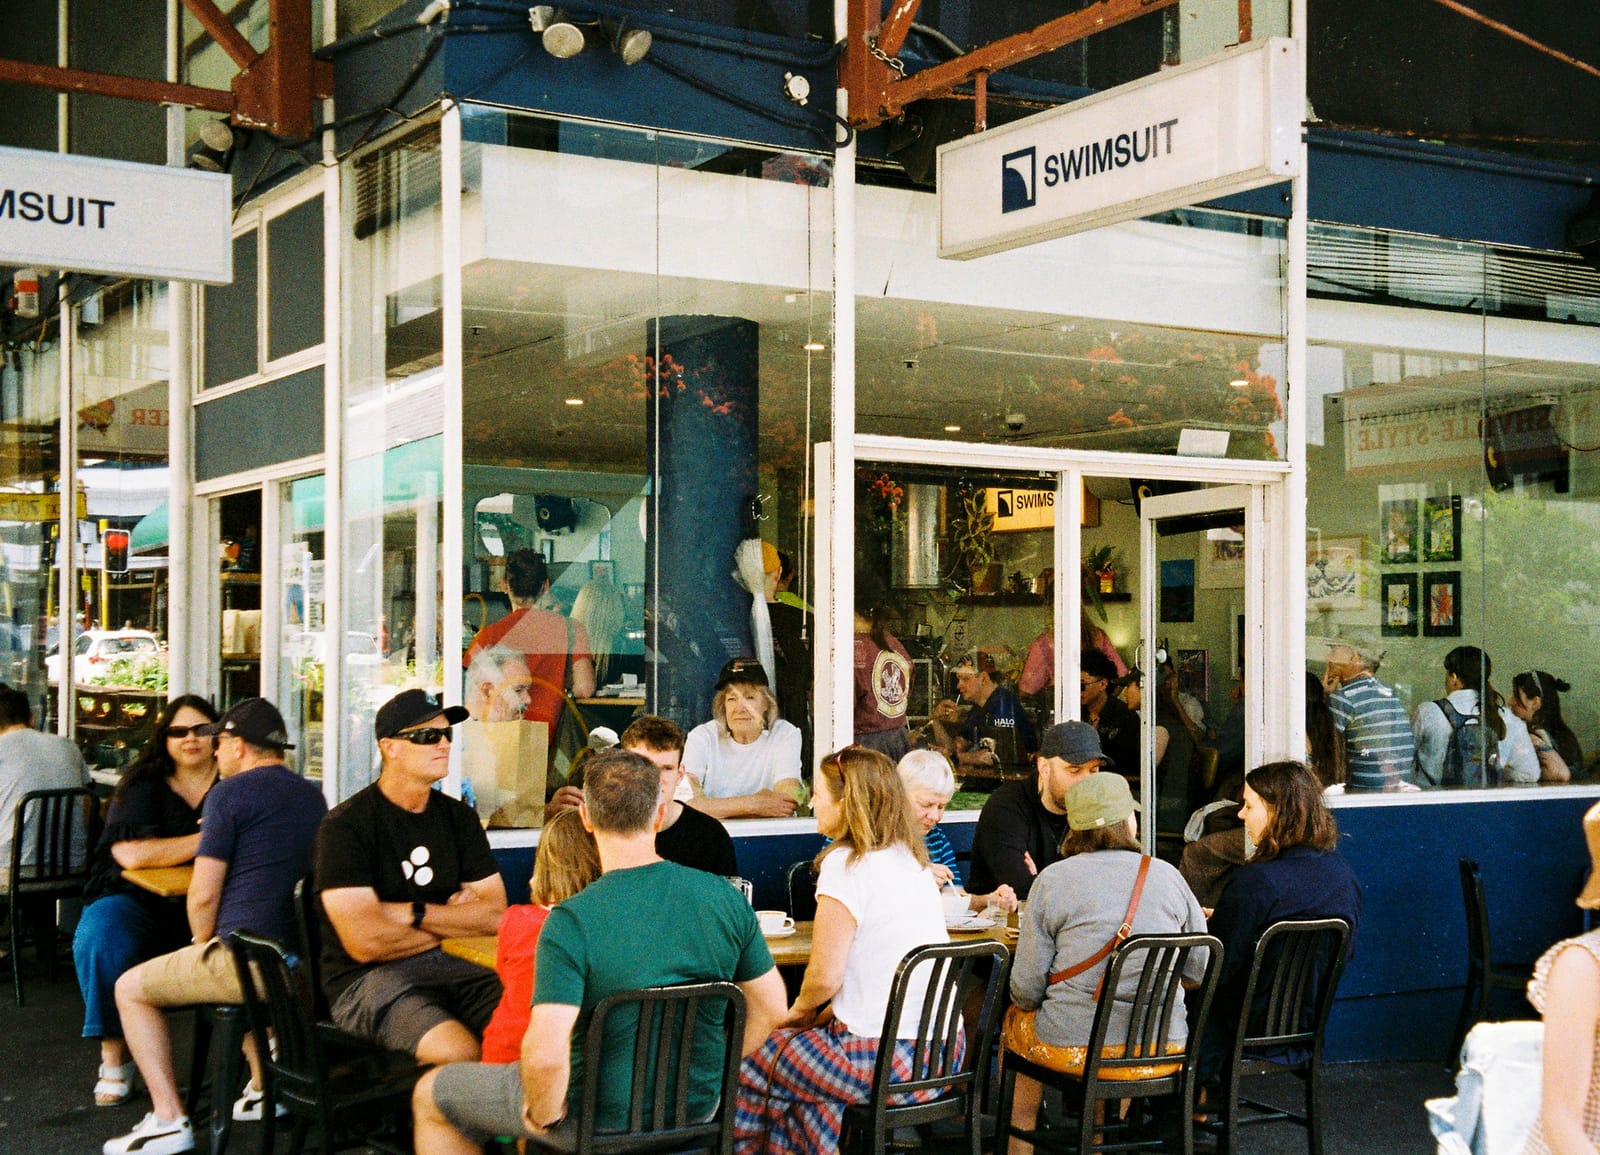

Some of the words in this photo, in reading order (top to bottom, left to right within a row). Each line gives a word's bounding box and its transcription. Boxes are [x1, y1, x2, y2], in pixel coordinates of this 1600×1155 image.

[1044, 118, 1178, 187] SWIMSUIT
[1016, 492, 1055, 510] SWIMS
[994, 717, 1015, 726] HALO
